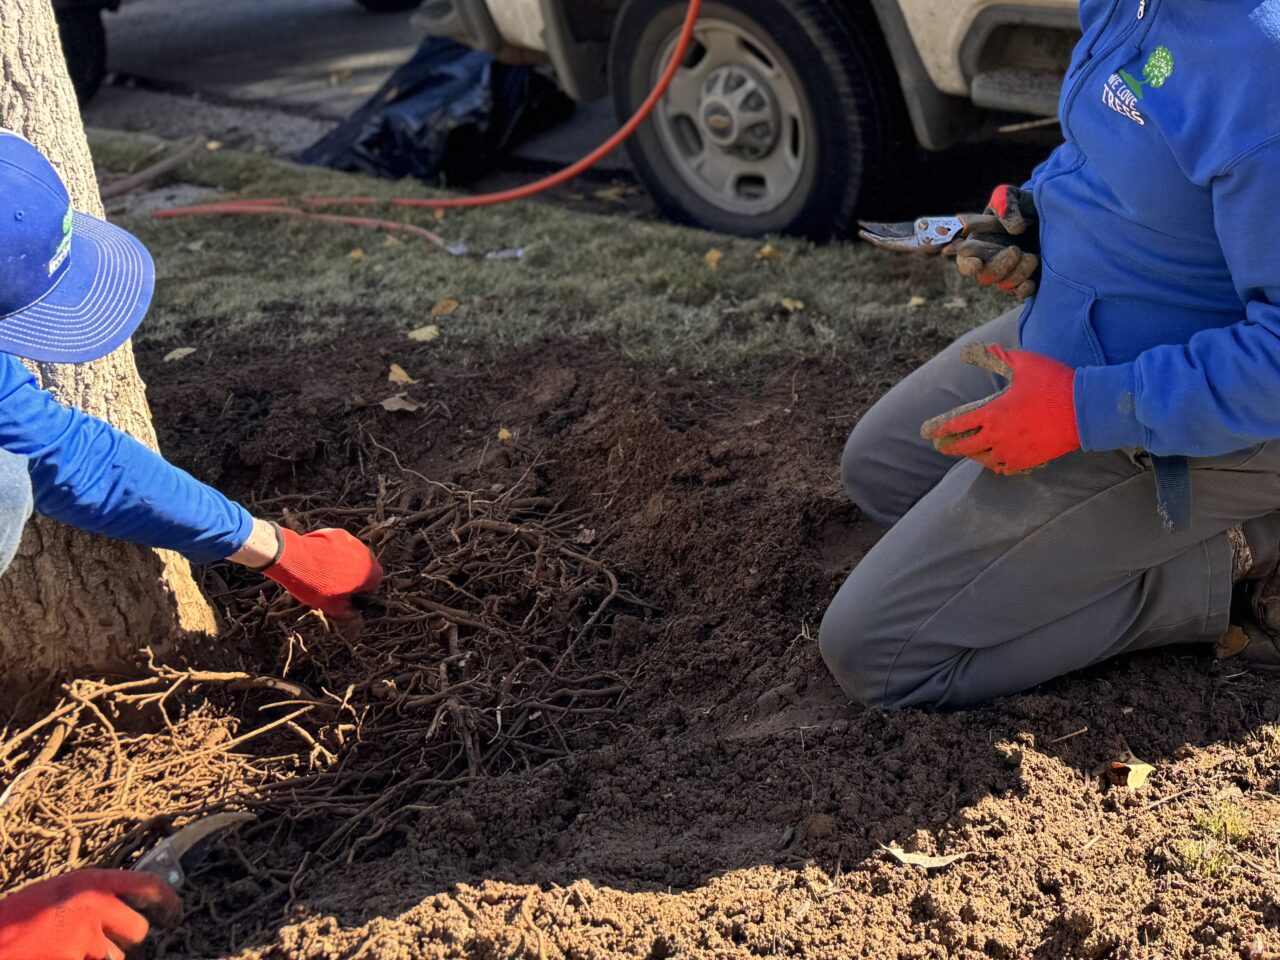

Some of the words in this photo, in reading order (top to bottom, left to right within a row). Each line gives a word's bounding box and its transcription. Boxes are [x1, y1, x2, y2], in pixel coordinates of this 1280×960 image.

[1102, 83, 1145, 126] TREES
[1107, 73, 1123, 90] WE
[1116, 84, 1138, 111] LOVE
